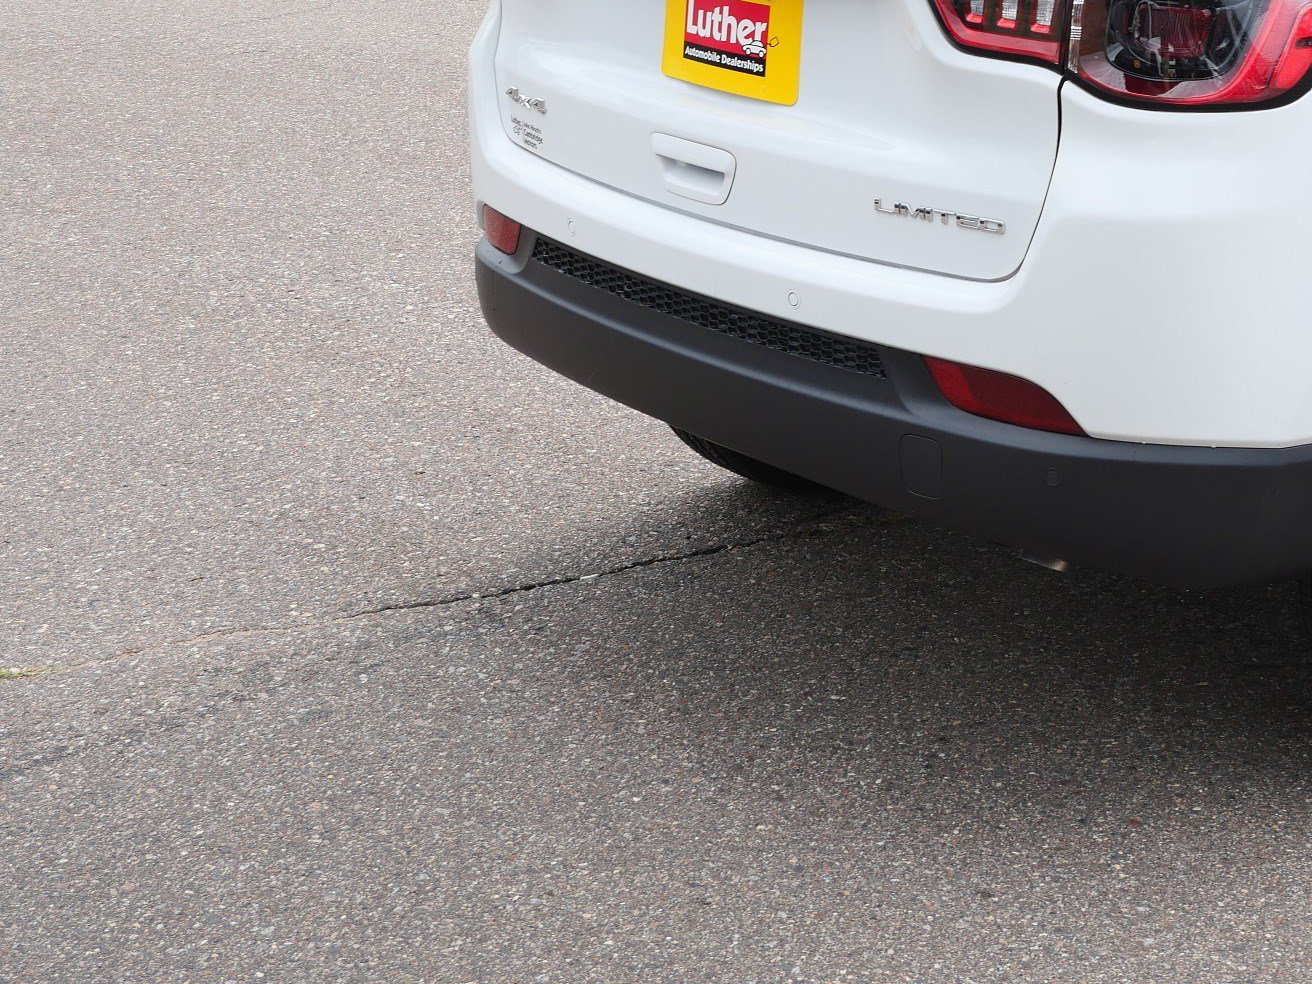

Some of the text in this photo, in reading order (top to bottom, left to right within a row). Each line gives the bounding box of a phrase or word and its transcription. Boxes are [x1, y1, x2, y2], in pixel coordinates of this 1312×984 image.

[685, 46, 764, 73] Automobile Dealerships
[873, 198, 1006, 235] LIMITED
